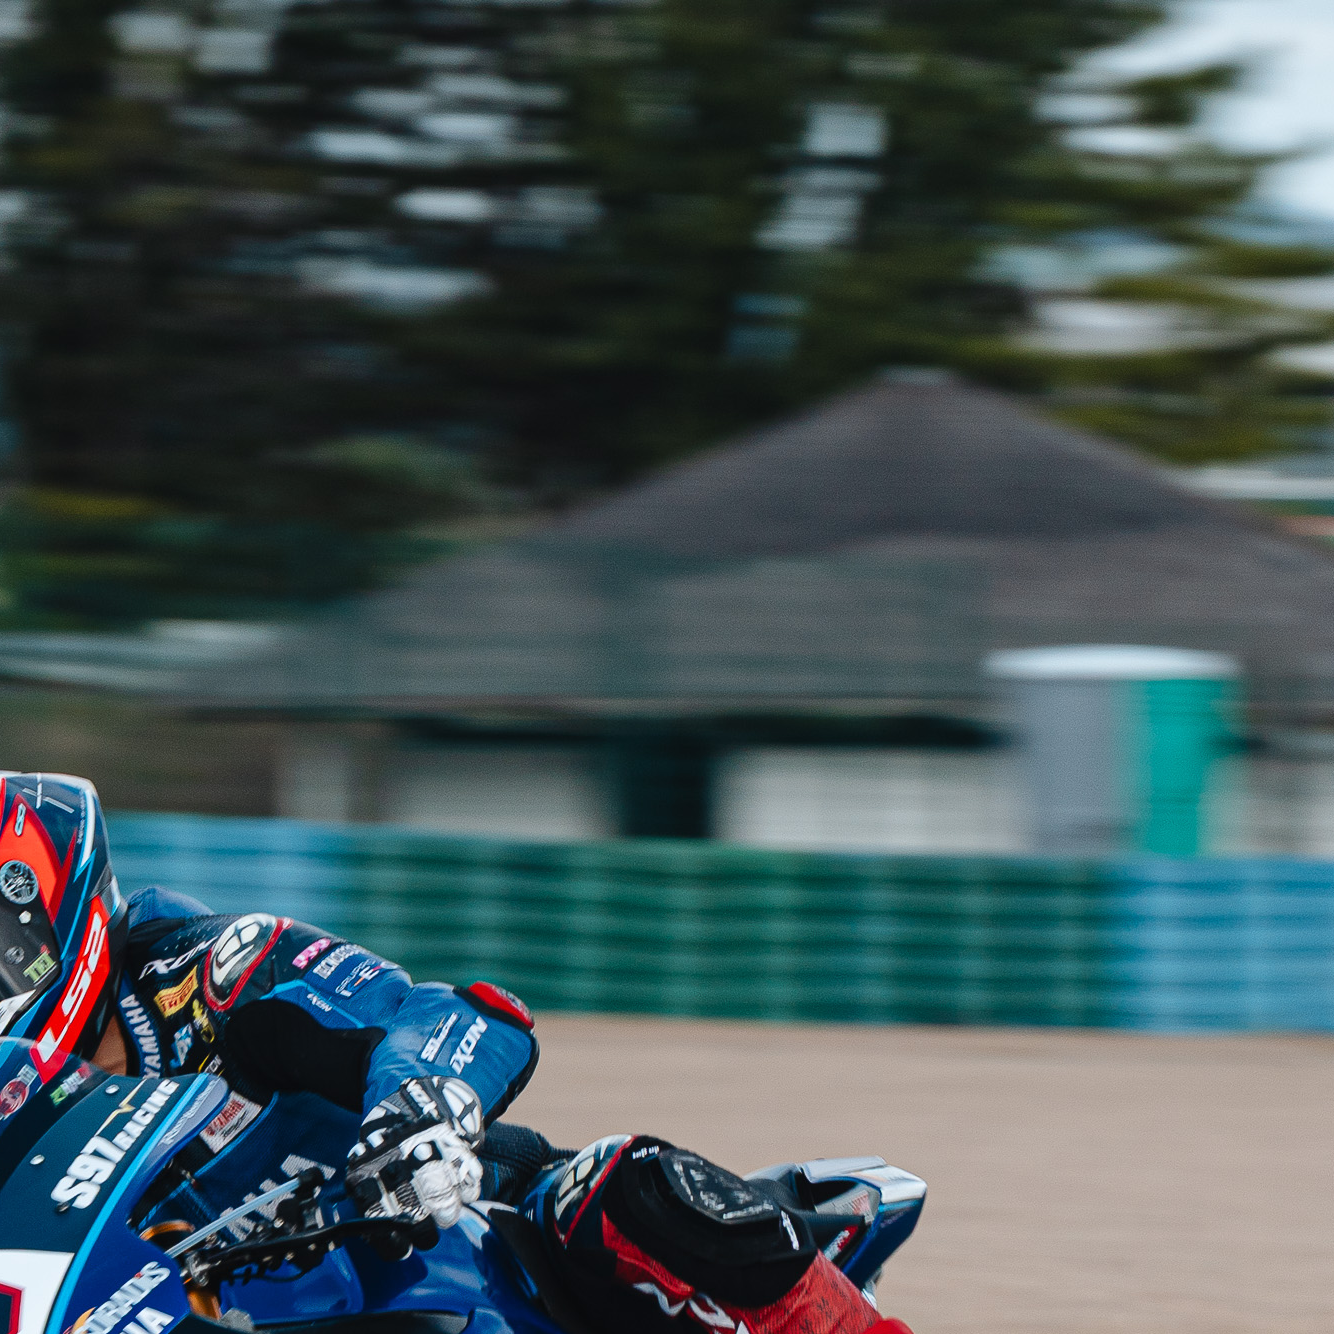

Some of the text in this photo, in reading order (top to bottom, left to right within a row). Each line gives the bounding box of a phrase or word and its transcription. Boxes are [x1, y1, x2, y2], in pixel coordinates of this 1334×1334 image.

[38, 913, 109, 1063] LS2
[120, 993, 161, 1080] YAMAHA
[50, 1136, 127, 1210] S97
[117, 1078, 180, 1150] RACING
